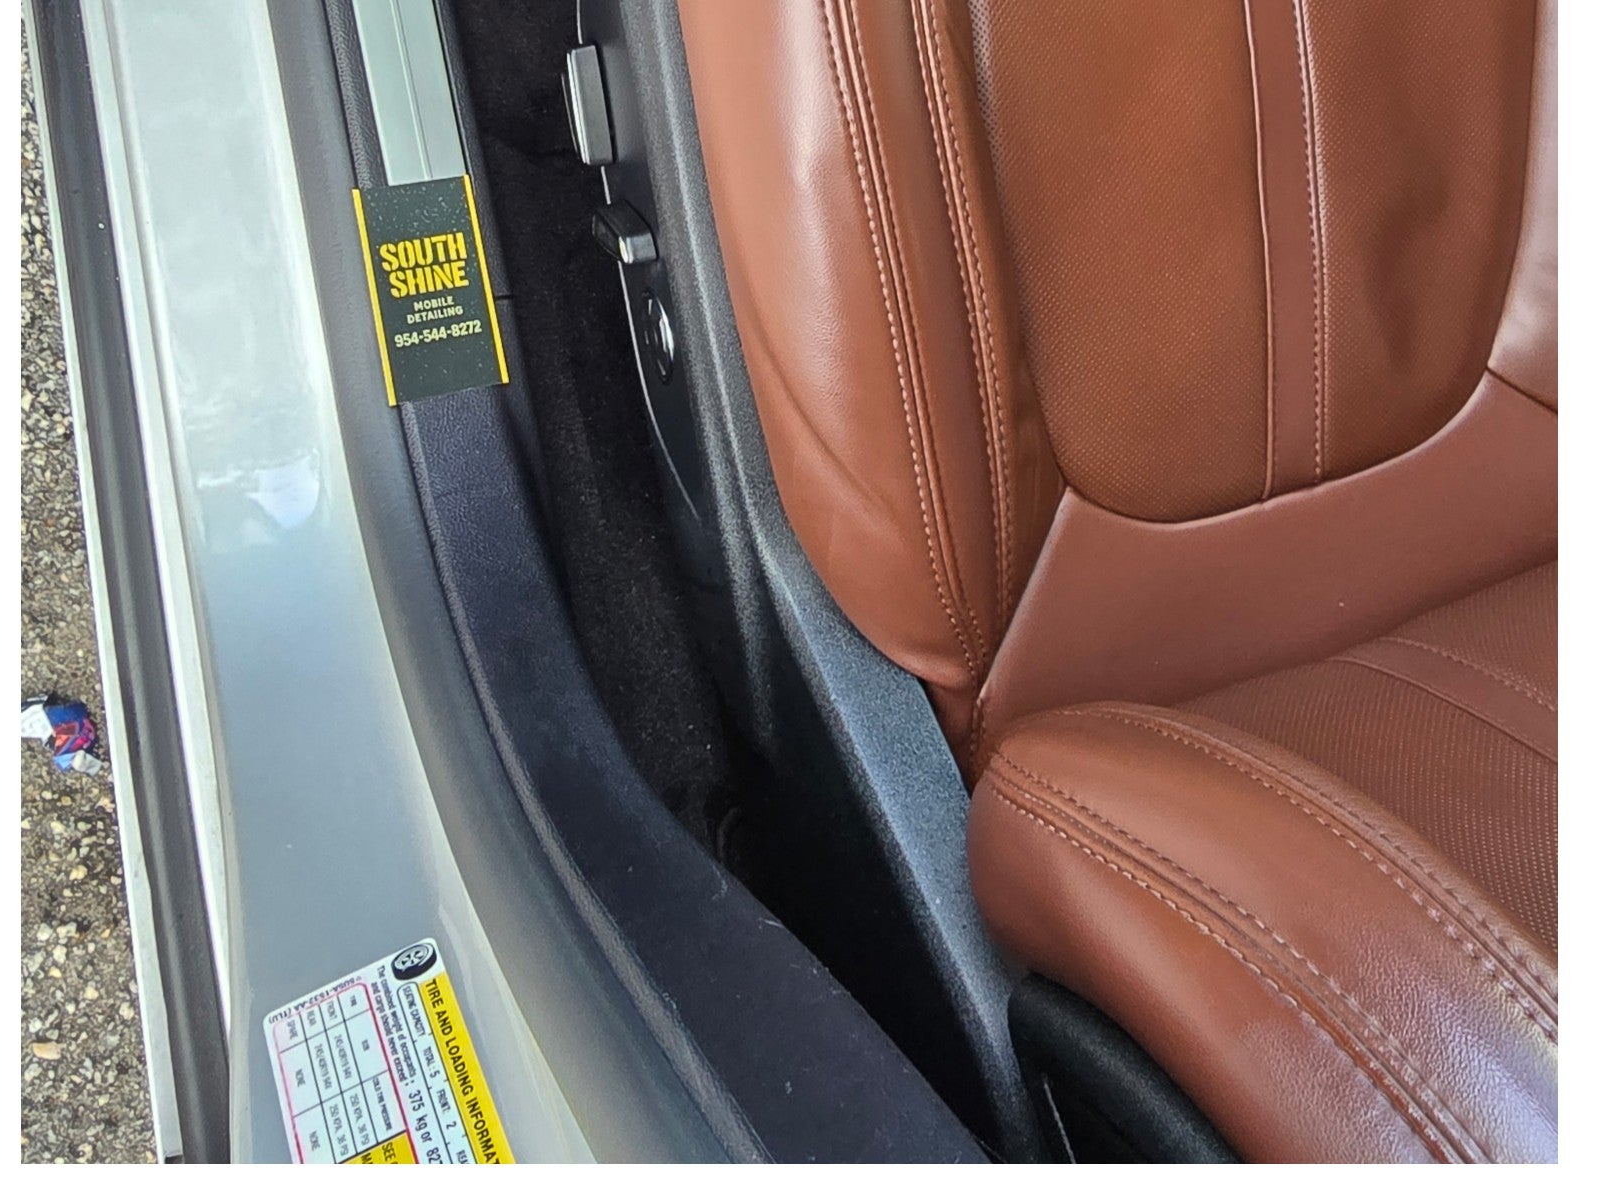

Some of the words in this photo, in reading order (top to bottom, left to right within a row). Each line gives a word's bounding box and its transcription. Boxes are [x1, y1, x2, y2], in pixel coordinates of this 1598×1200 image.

[379, 232, 467, 271] SOUTH
[389, 261, 470, 298] SHINE
[413, 296, 454, 311] MOBILE
[407, 307, 463, 324] DETAILING
[394, 319, 482, 348] 954-544-8272
[376, 965, 386, 978] The
[380, 978, 395, 1009] combined
[370, 981, 380, 994] and
[375, 995, 385, 1013] cargo
[381, 1014, 392, 1035] should
[387, 1037, 397, 1055] never
[390, 1010, 402, 1032] weight
[410, 1009, 425, 1036] CAPACITY
[397, 1033, 405, 1041] of
[425, 978, 443, 1007] TIRE
[435, 1009, 453, 1035] AND
[445, 1037, 474, 1096] LOADING
[400, 1042, 416, 1076] occupants
[429, 1070, 440, 1078] 5
[408, 1089, 425, 1111] 375
[416, 1114, 428, 1131] kg
[445, 1121, 456, 1129] 2
[420, 1131, 432, 1143] or
[381, 1141, 395, 1161] SEE
